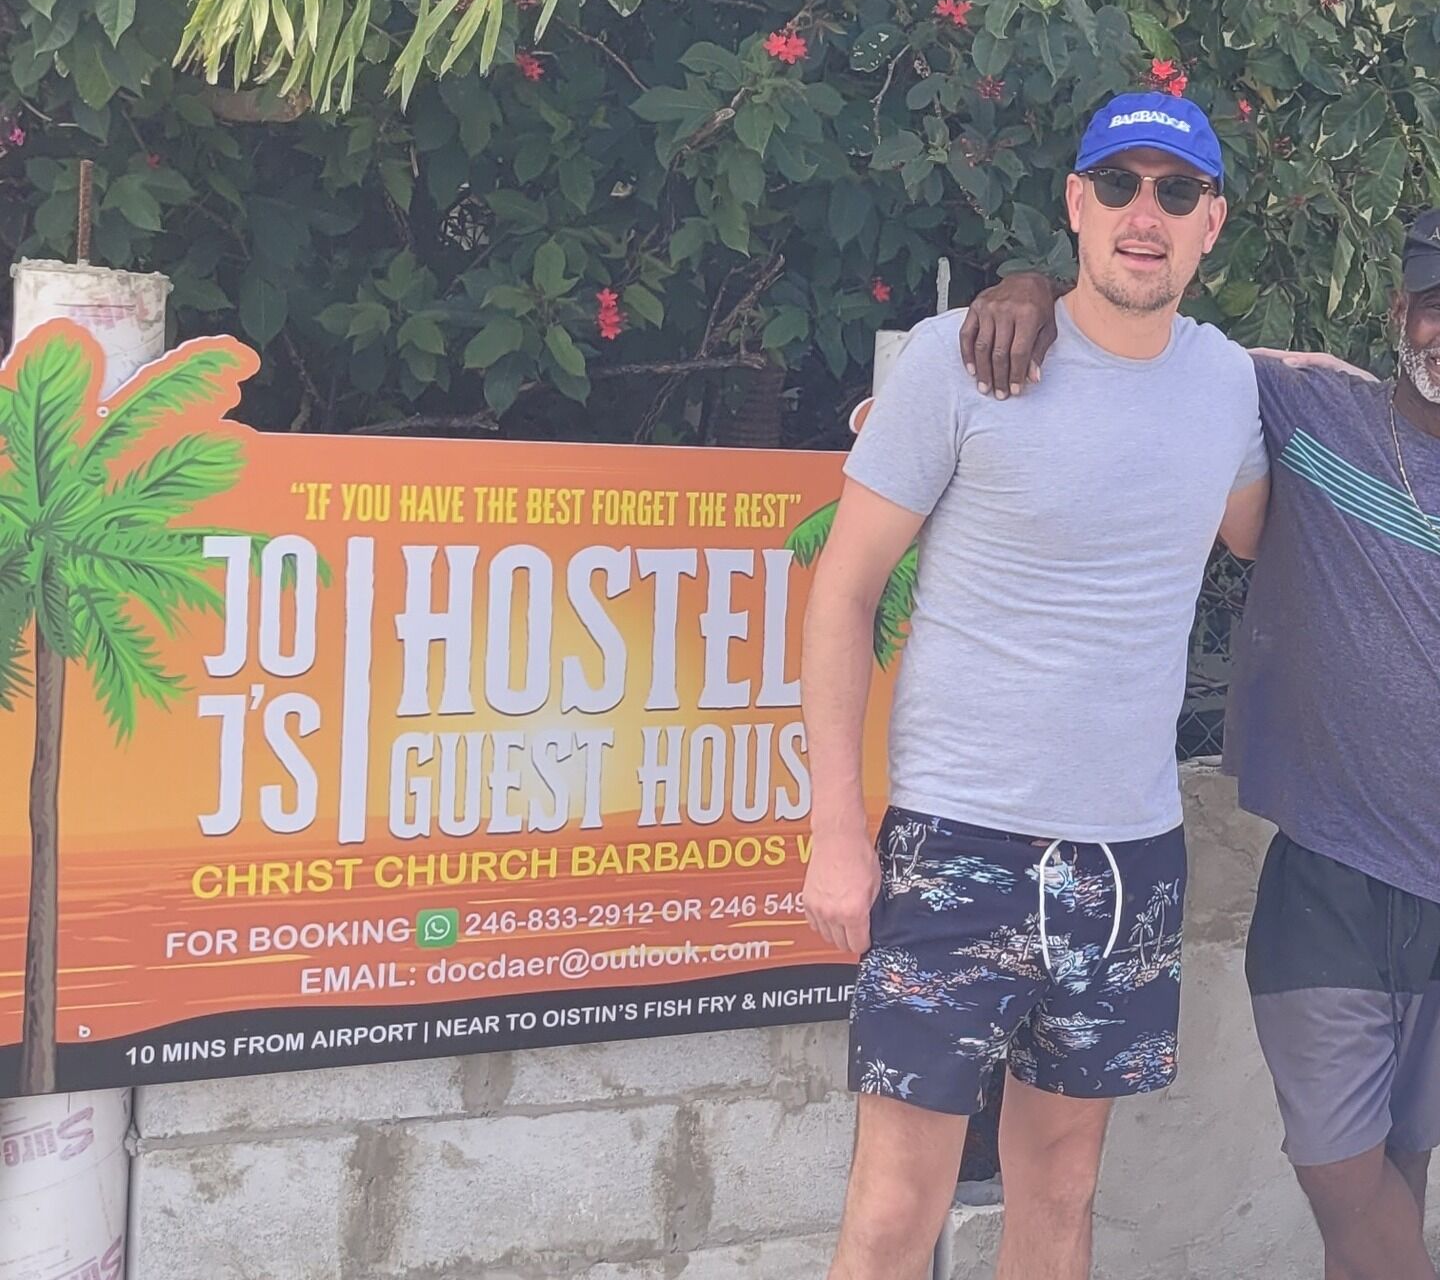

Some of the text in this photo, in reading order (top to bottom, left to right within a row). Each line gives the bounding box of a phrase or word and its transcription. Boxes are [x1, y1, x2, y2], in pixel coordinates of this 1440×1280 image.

[341, 483, 391, 522] YOU
[400, 485, 465, 524] HAVE
[473, 486, 518, 524] THE
[526, 488, 586, 525] BEST
[592, 489, 679, 527] FORGET
[686, 491, 727, 528] THE
[202, 534, 318, 677] JO
[395, 544, 801, 716] HOSTEL
[198, 683, 321, 836] J'S
[388, 727, 615, 840] GUEST
[191, 858, 364, 900] CHRIST
[374, 847, 558, 889] CHURCH
[571, 835, 786, 876] BARBADOS
[166, 929, 238, 959] FOR
[249, 918, 411, 953] BOOKING
[464, 902, 654, 937] 246-833-2912
[661, 899, 702, 922] OR
[709, 895, 757, 920] 246
[301, 940, 770, 995] EMAIL: docdaer@outlook.com
[125, 1045, 155, 1066] 10
[162, 1039, 226, 1063] MINS
[233, 1032, 304, 1056] FROM
[310, 1022, 418, 1050] AIRPORT
[435, 1015, 500, 1038] NEAR
[505, 1012, 537, 1031] TO
[542, 1003, 638, 1027] OISTIN'S
[644, 998, 692, 1019] FISH
[697, 994, 737, 1014] FRY
[741, 992, 757, 1010] &
